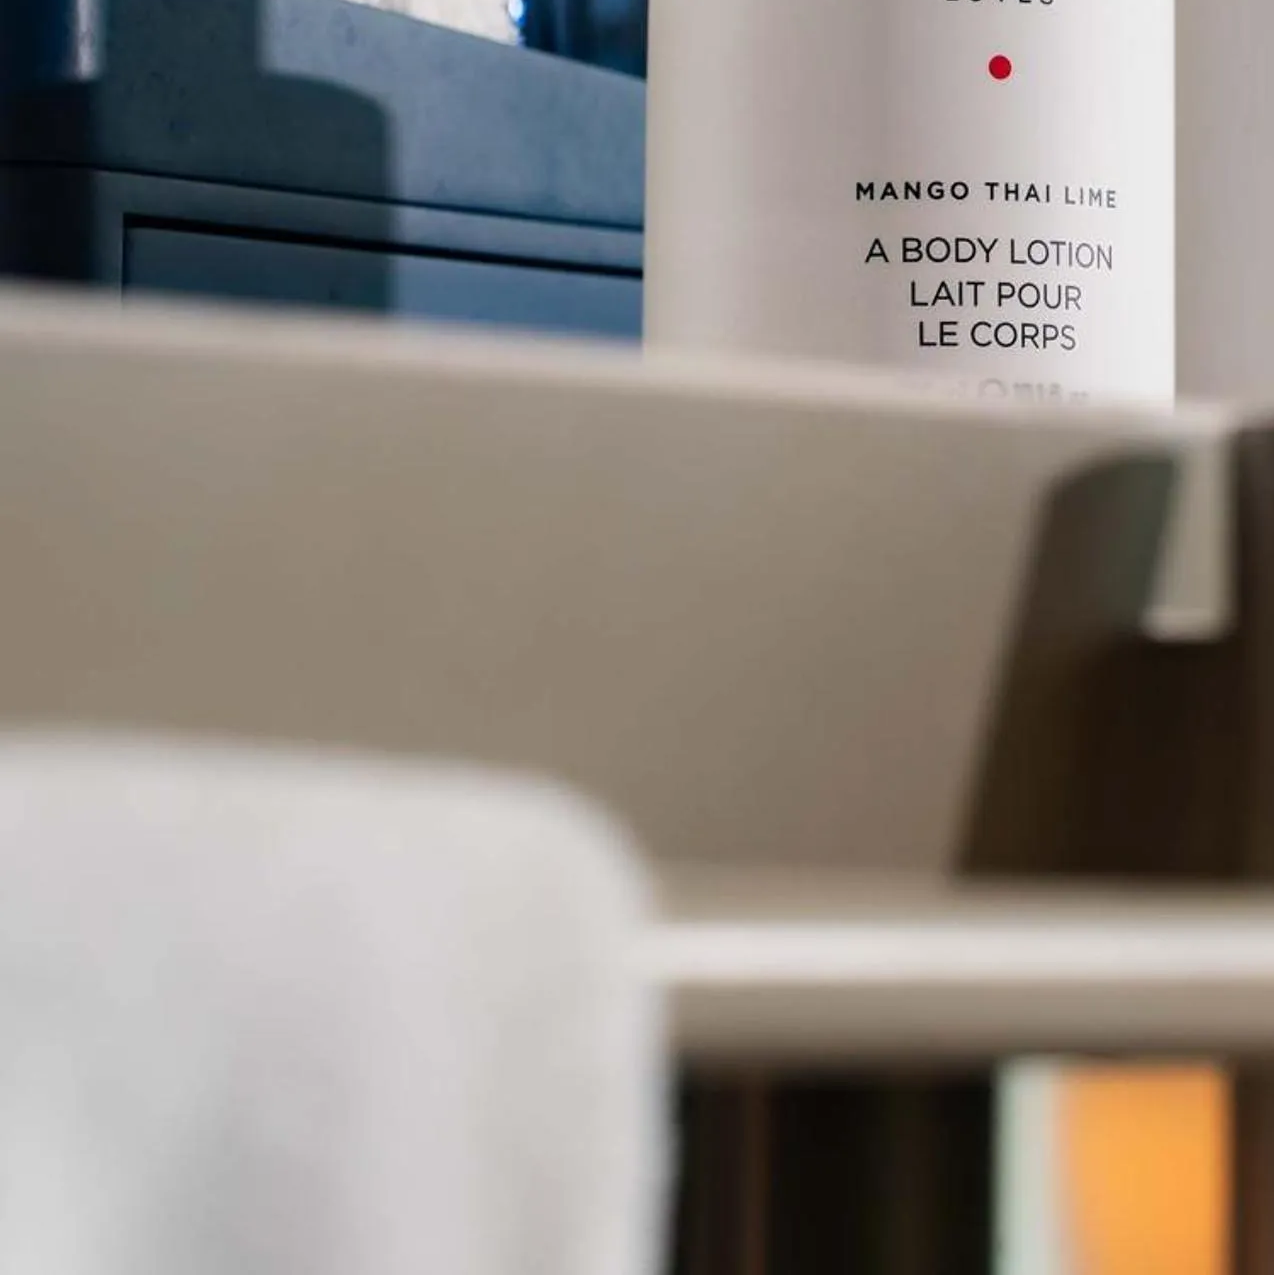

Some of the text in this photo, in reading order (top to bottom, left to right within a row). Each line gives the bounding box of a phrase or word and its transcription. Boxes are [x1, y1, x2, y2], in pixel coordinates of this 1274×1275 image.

[855, 181, 1118, 208] MANGO THAI LIME
[864, 237, 1113, 270] A BODY LOTION
[910, 281, 1083, 311] LAIT POUR
[917, 321, 1077, 351] LE CORPS
